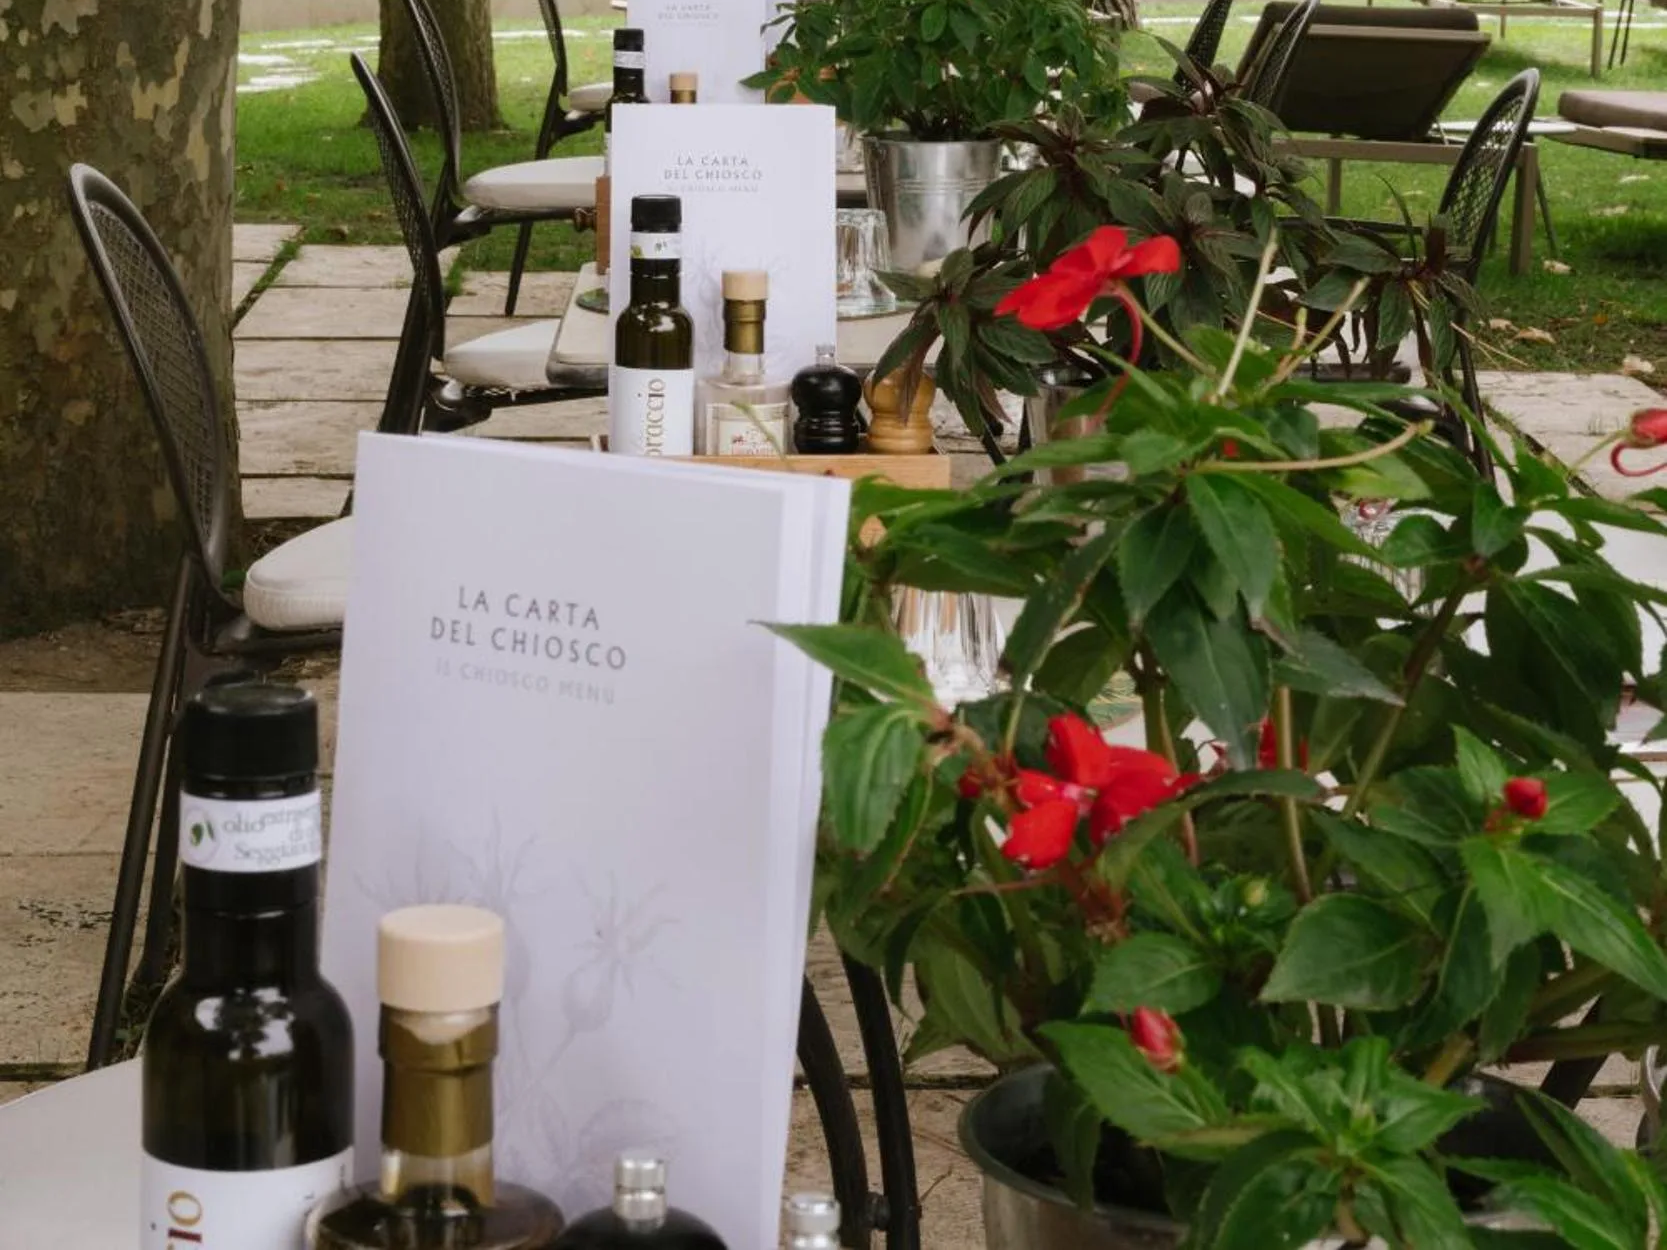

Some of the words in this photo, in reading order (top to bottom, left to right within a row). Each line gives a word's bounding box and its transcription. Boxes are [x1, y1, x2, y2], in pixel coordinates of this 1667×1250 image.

[663, 169, 689, 180] DEL
[694, 169, 764, 180] CHIOSCO
[677, 155, 694, 166] LA
[701, 155, 749, 167] CARTA
[457, 585, 490, 614] LA
[504, 593, 600, 631] CARTA
[430, 616, 476, 647] DEL
[490, 627, 627, 671] CHIOSCO
[458, 661, 550, 693] CHIOSCO
